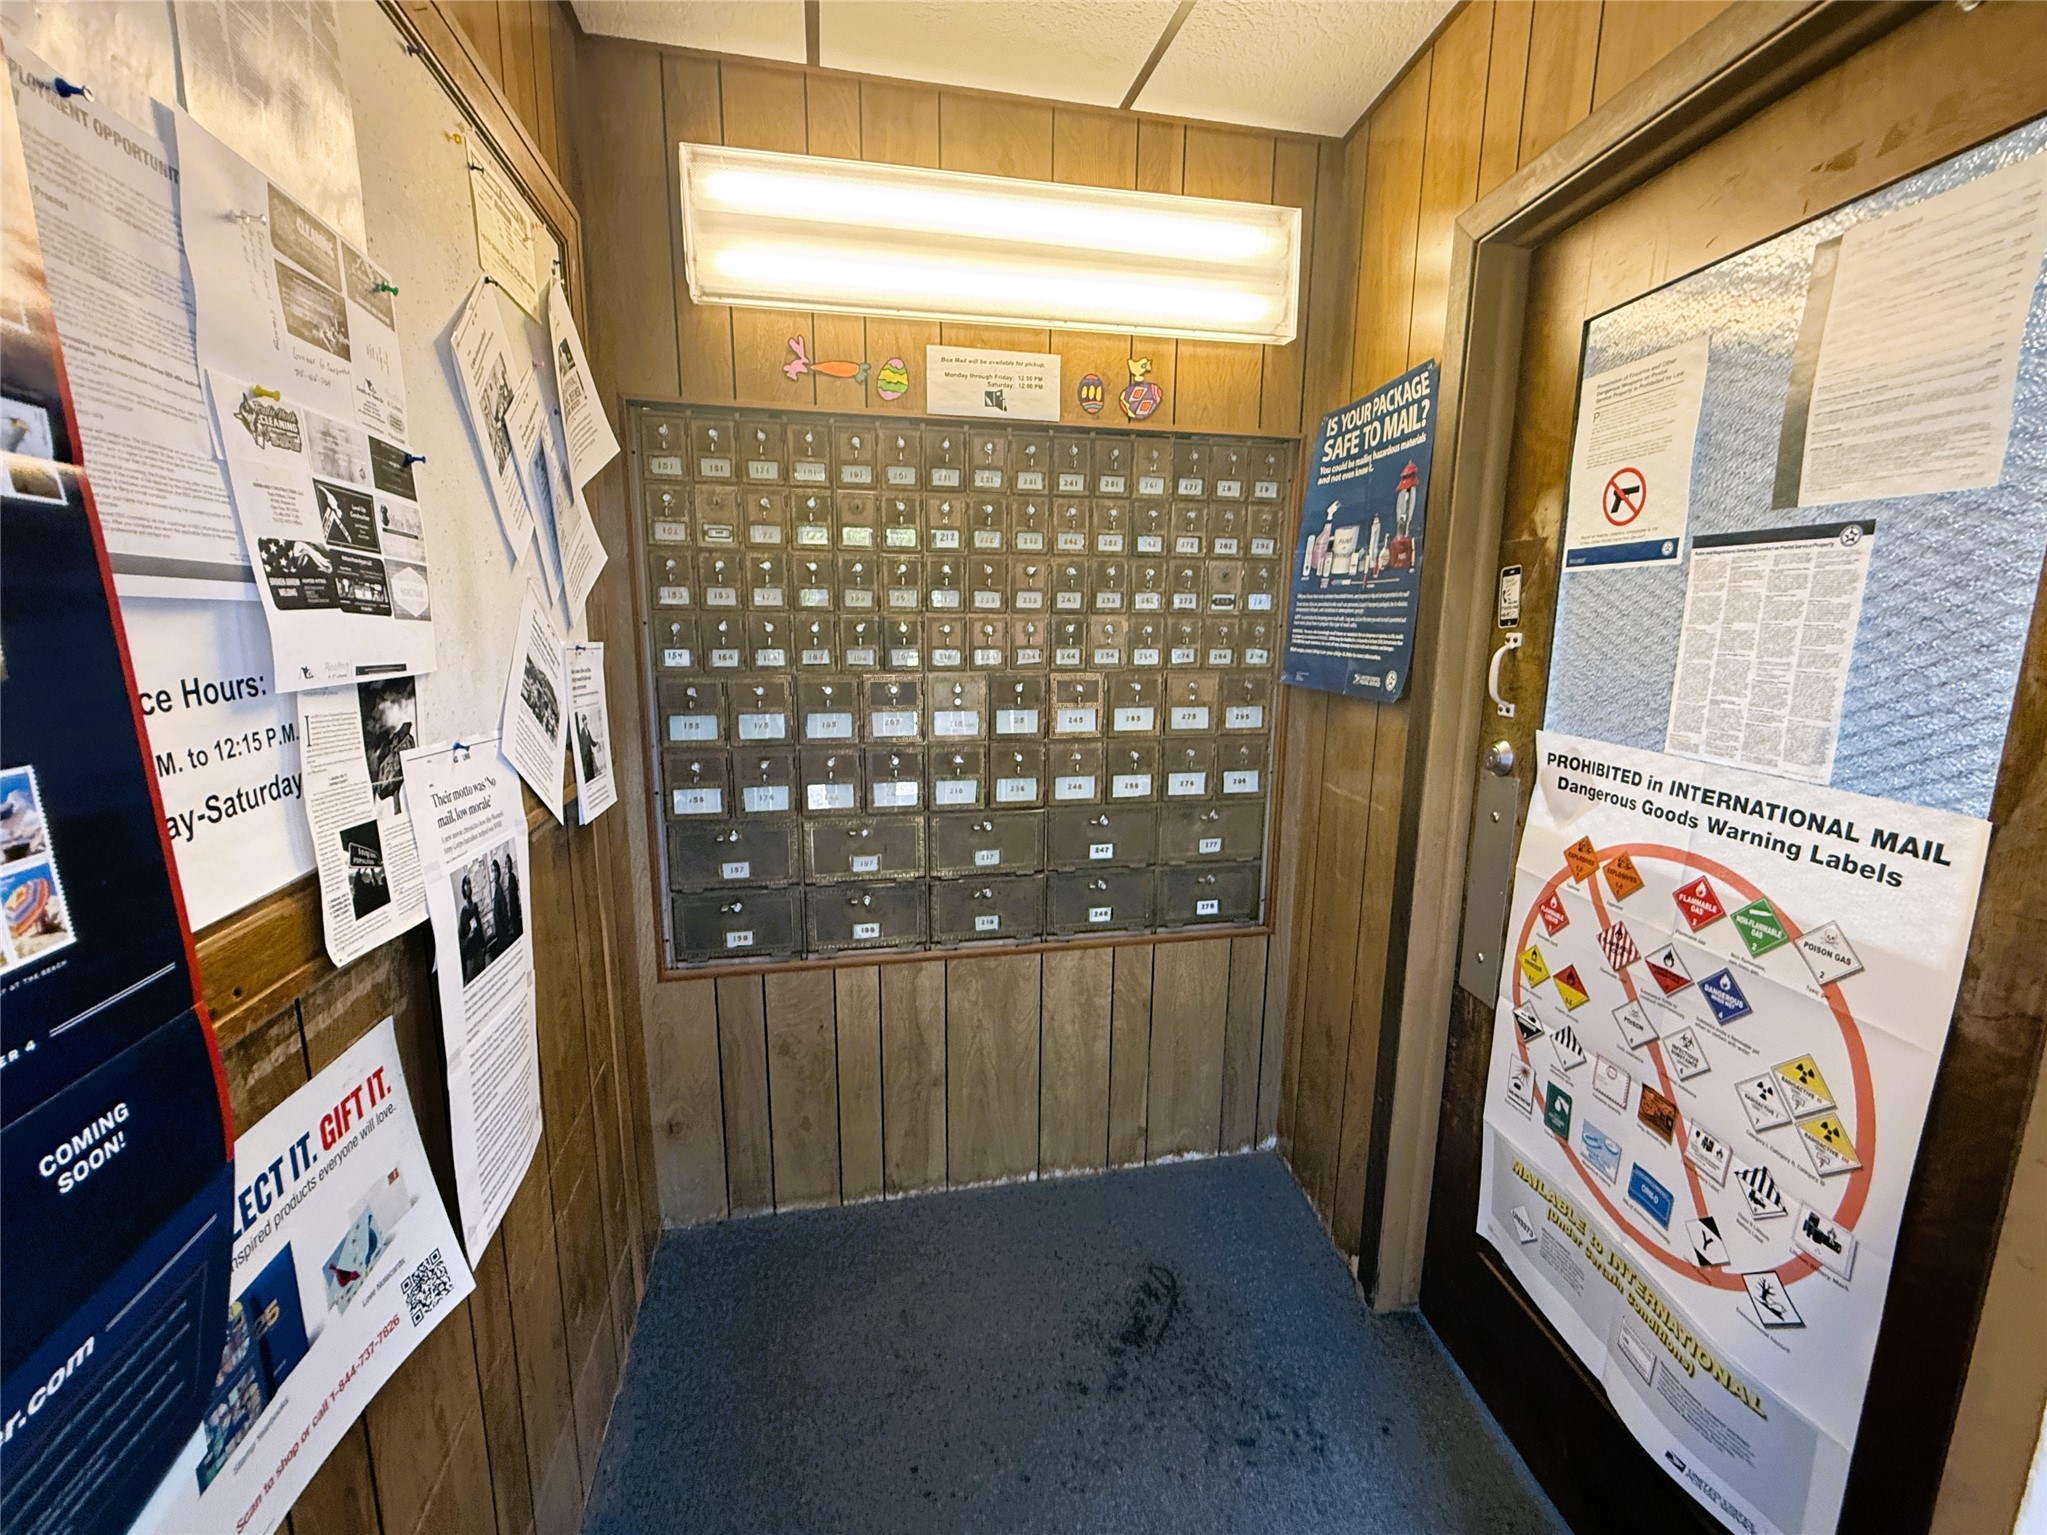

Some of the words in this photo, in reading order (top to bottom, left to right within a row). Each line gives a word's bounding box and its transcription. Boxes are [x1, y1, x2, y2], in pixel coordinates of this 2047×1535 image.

[970, 373, 993, 381] through
[1327, 417, 1338, 437] IS
[1341, 402, 1372, 432] YOUR
[1373, 371, 1430, 418] PACKAGE
[1322, 430, 1360, 462] SAFE
[1363, 421, 1381, 450] TO
[1383, 399, 1430, 442] MAIL?
[1320, 466, 1331, 474] You
[1332, 461, 1347, 472] could
[1356, 453, 1372, 466] mailing
[1373, 444, 1400, 460] hazardous
[1401, 432, 1426, 449] materials
[1318, 475, 1329, 485] and
[1331, 473, 1341, 482] not
[1342, 471, 1355, 480] even
[1356, 467, 1367, 476] know
[940, 533, 955, 542] 212
[181, 676, 266, 708] Hours:
[156, 752, 183, 778] M.
[188, 748, 208, 768] to
[214, 731, 262, 761] 12:15
[266, 723, 300, 748] P.M.
[166, 772, 302, 842] ay-Saturday
[430, 790, 451, 808] Their
[452, 786, 473, 801] motto
[474, 782, 486, 792] was
[437, 808, 456, 828] mail,
[455, 808, 468, 820] low
[1547, 752, 1643, 787] PROHIBITED
[1647, 775, 1663, 793] in
[1669, 780, 1860, 843] INTERNATIONAL
[1870, 828, 1951, 867] MAIL
[1557, 776, 1637, 810] Dangerous
[1642, 799, 1699, 829] Goods
[1708, 816, 1802, 861] Warning
[1810, 845, 1903, 887] Labels
[1607, 867, 1636, 884] EXPLOSIVES
[1679, 894, 1717, 913] FLAMMABLE
[1690, 905, 1704, 915] GAS
[1736, 915, 1782, 939] NON-FLAMMABLE
[1751, 929, 1764, 940] GAS
[1803, 942, 1832, 958] POISON
[1835, 953, 1851, 966] GAS
[1704, 984, 1744, 1008] DANGEROUS
[1624, 1016, 1644, 1031] POISON
[25, 1040, 36, 1052] 4
[1672, 1044, 1699, 1064] INFECTIOUS
[1671, 1050, 1698, 1068] SUBSTANCE
[1781, 1076, 1814, 1099] RADIOACTIVE
[1745, 1093, 1774, 1116] RADIOACTIVE
[289, 1132, 318, 1182] IT.
[320, 1084, 364, 1152] GIFT
[367, 1066, 392, 1108] IT.
[39, 1102, 129, 1178] COMING
[1804, 1133, 1838, 1158] RADIOACTIVE
[57, 1131, 126, 1194] SOON!
[274, 1180, 317, 1233] products
[318, 1136, 358, 1182] everyone
[360, 1117, 375, 1139] will
[376, 1102, 396, 1127] love.
[1512, 1209, 1534, 1238] UN3373
[1702, 1230, 1713, 1250] Y
[1512, 1158, 1587, 1236] MAILABLE
[1607, 1248, 1768, 1421] INTERNATIONAL
[1546, 1208, 1583, 1248] (Under
[1585, 1247, 1625, 1295] Certain
[1627, 1295, 1696, 1379] Conditions)
[236, 1494, 262, 1534] Scan
[264, 1476, 274, 1495] to
[275, 1442, 300, 1478] shop
[301, 1425, 311, 1444] or
[313, 1399, 329, 1427] call
[329, 1314, 400, 1402] 1-844-737-7826
